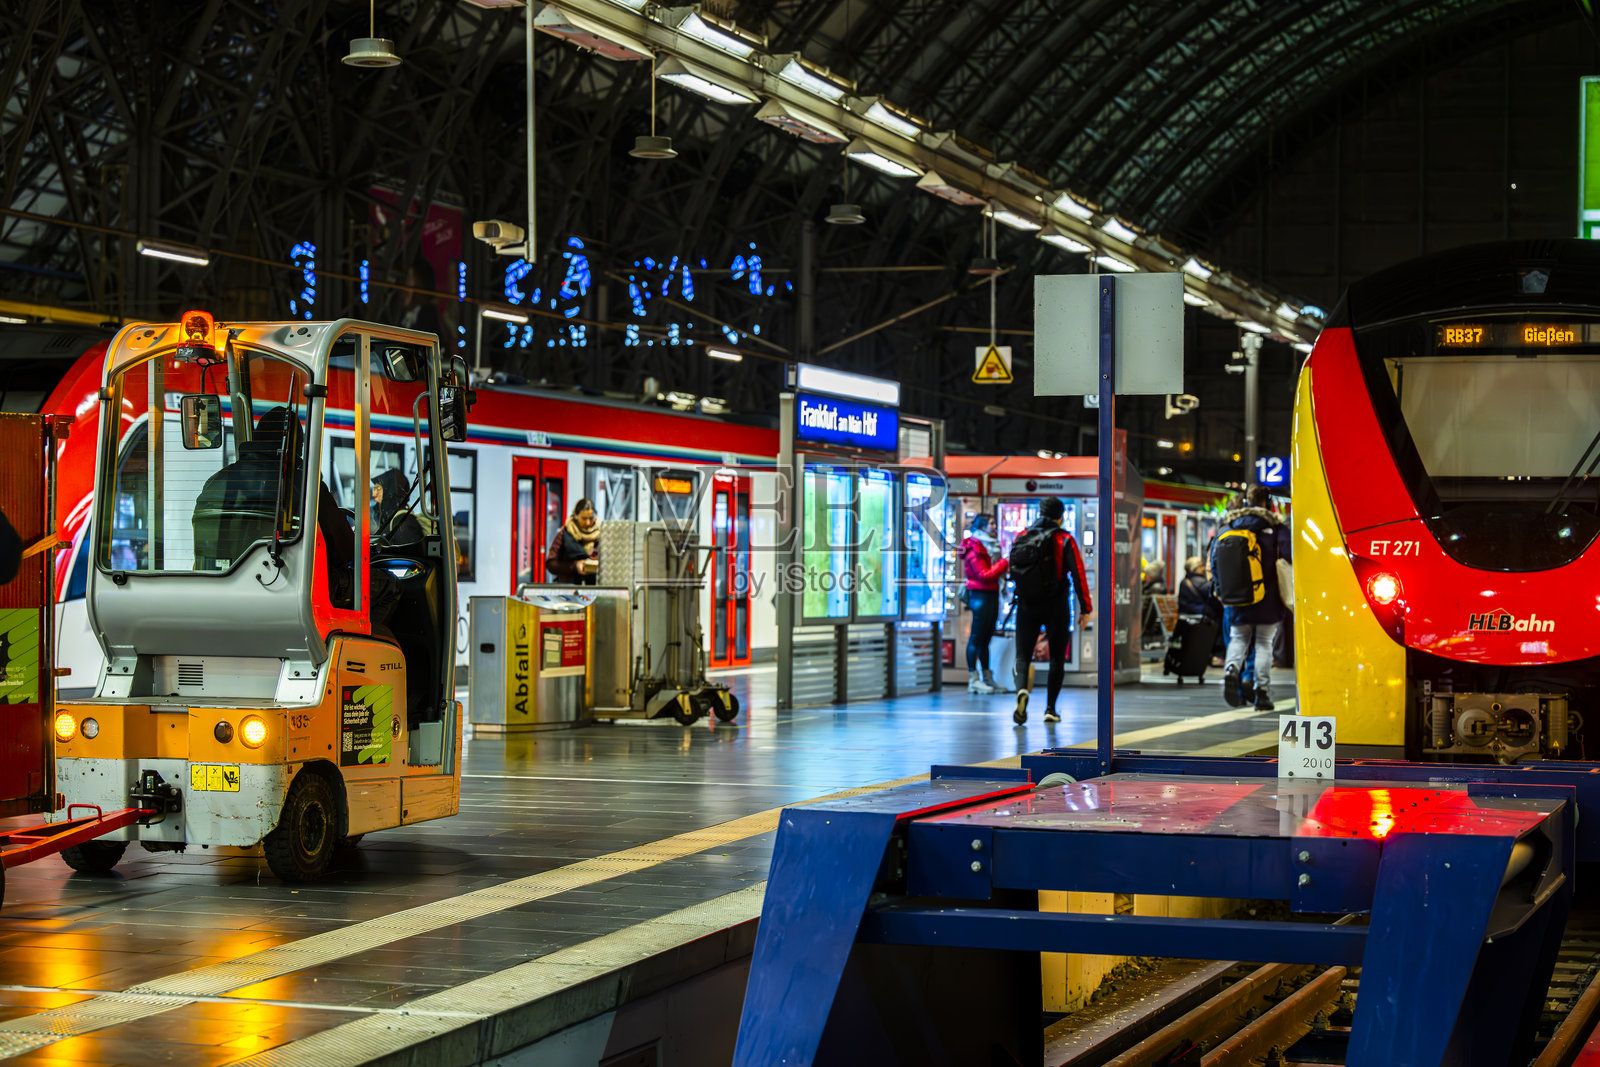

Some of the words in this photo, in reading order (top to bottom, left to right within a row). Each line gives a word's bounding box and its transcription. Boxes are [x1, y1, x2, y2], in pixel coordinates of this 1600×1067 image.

[1446, 328, 1483, 343] RB37
[1524, 327, 1574, 346] Gießen
[800, 400, 838, 431] Frankfurt
[838, 417, 848, 432] am
[848, 414, 862, 434] Main
[862, 411, 878, 437] Hbf
[1255, 456, 1283, 482] 12
[1370, 540, 1391, 556] ET
[1393, 540, 1421, 557] 271
[380, 662, 403, 671] STILL
[514, 643, 529, 715] Abfall
[1281, 720, 1333, 750] 413
[1303, 757, 1332, 769] 2010
